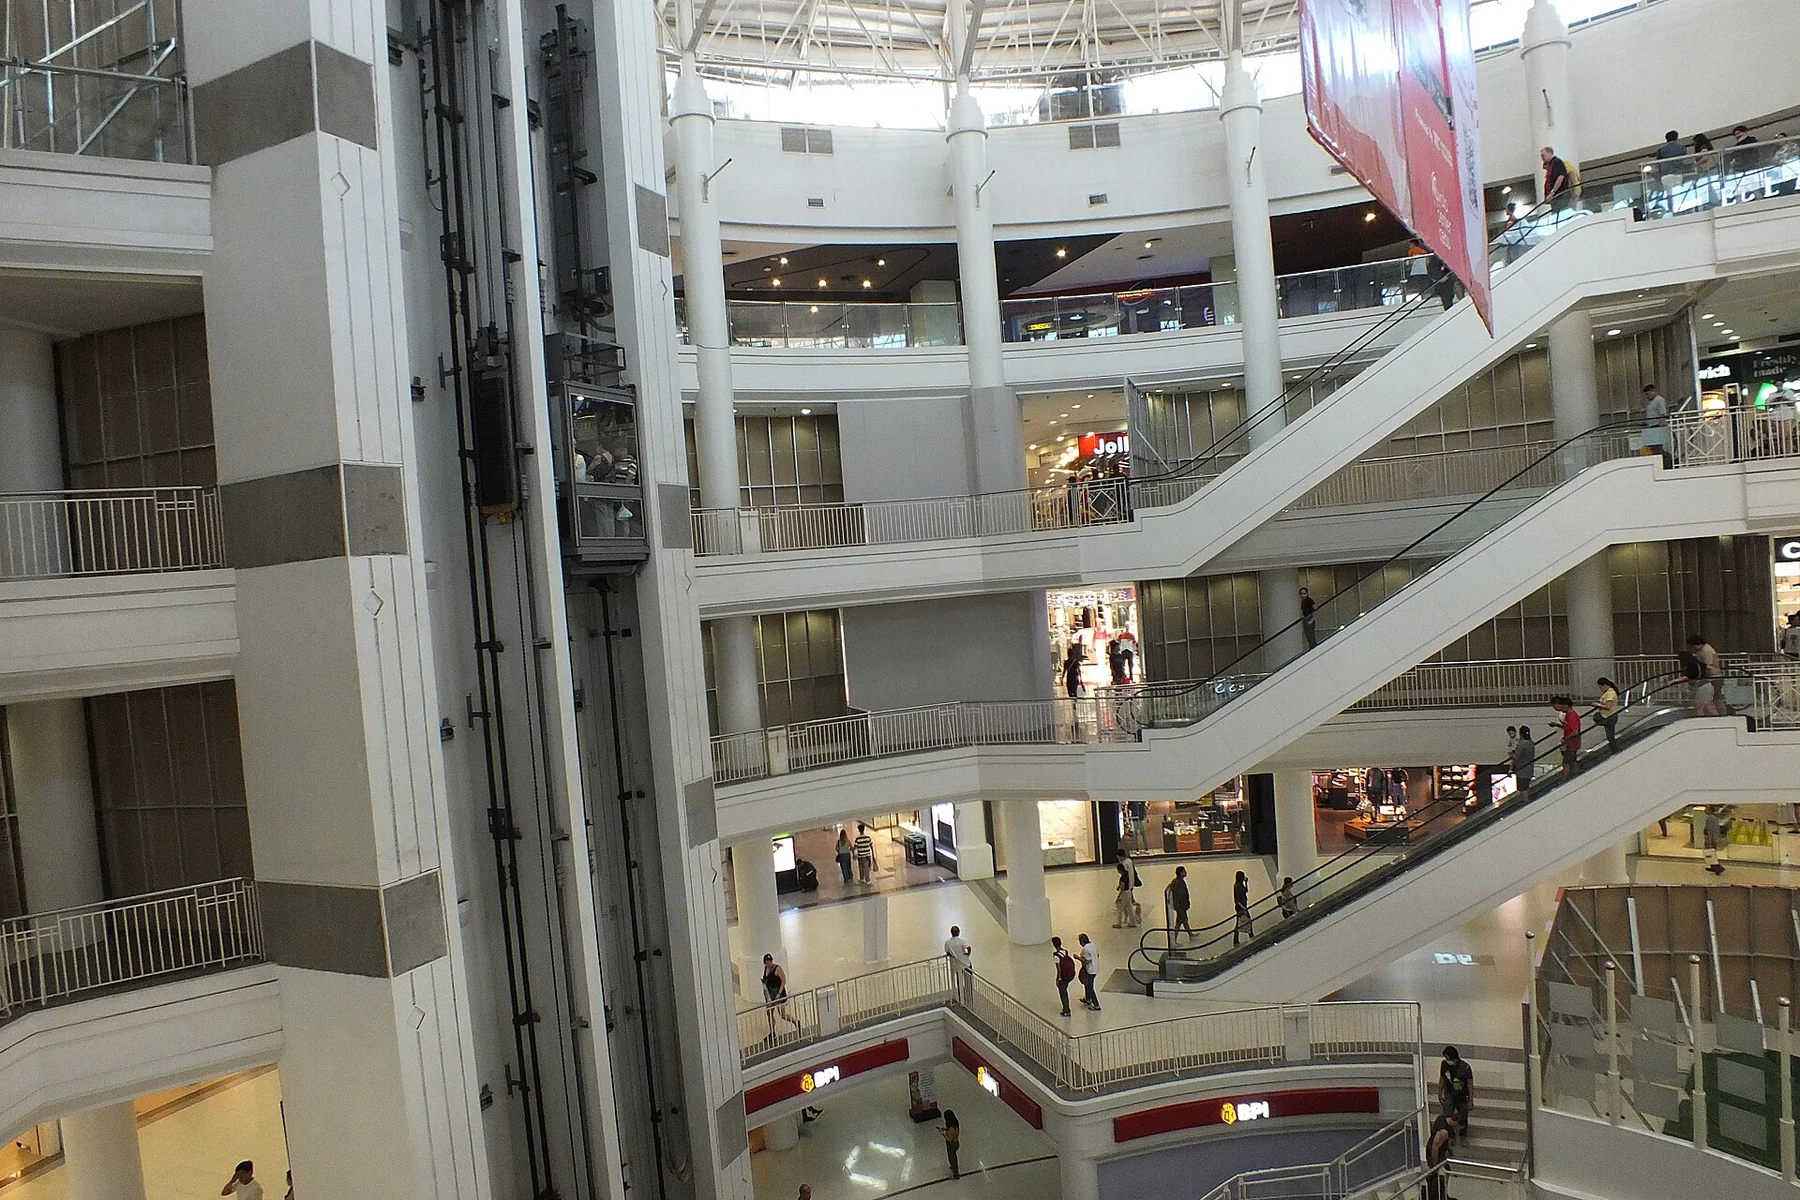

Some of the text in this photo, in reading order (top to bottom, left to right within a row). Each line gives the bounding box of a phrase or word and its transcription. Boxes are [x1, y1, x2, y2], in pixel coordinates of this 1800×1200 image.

[1093, 436, 1129, 455] Joll
[814, 1065, 840, 1088] BPI
[1237, 1101, 1270, 1121] BPI
